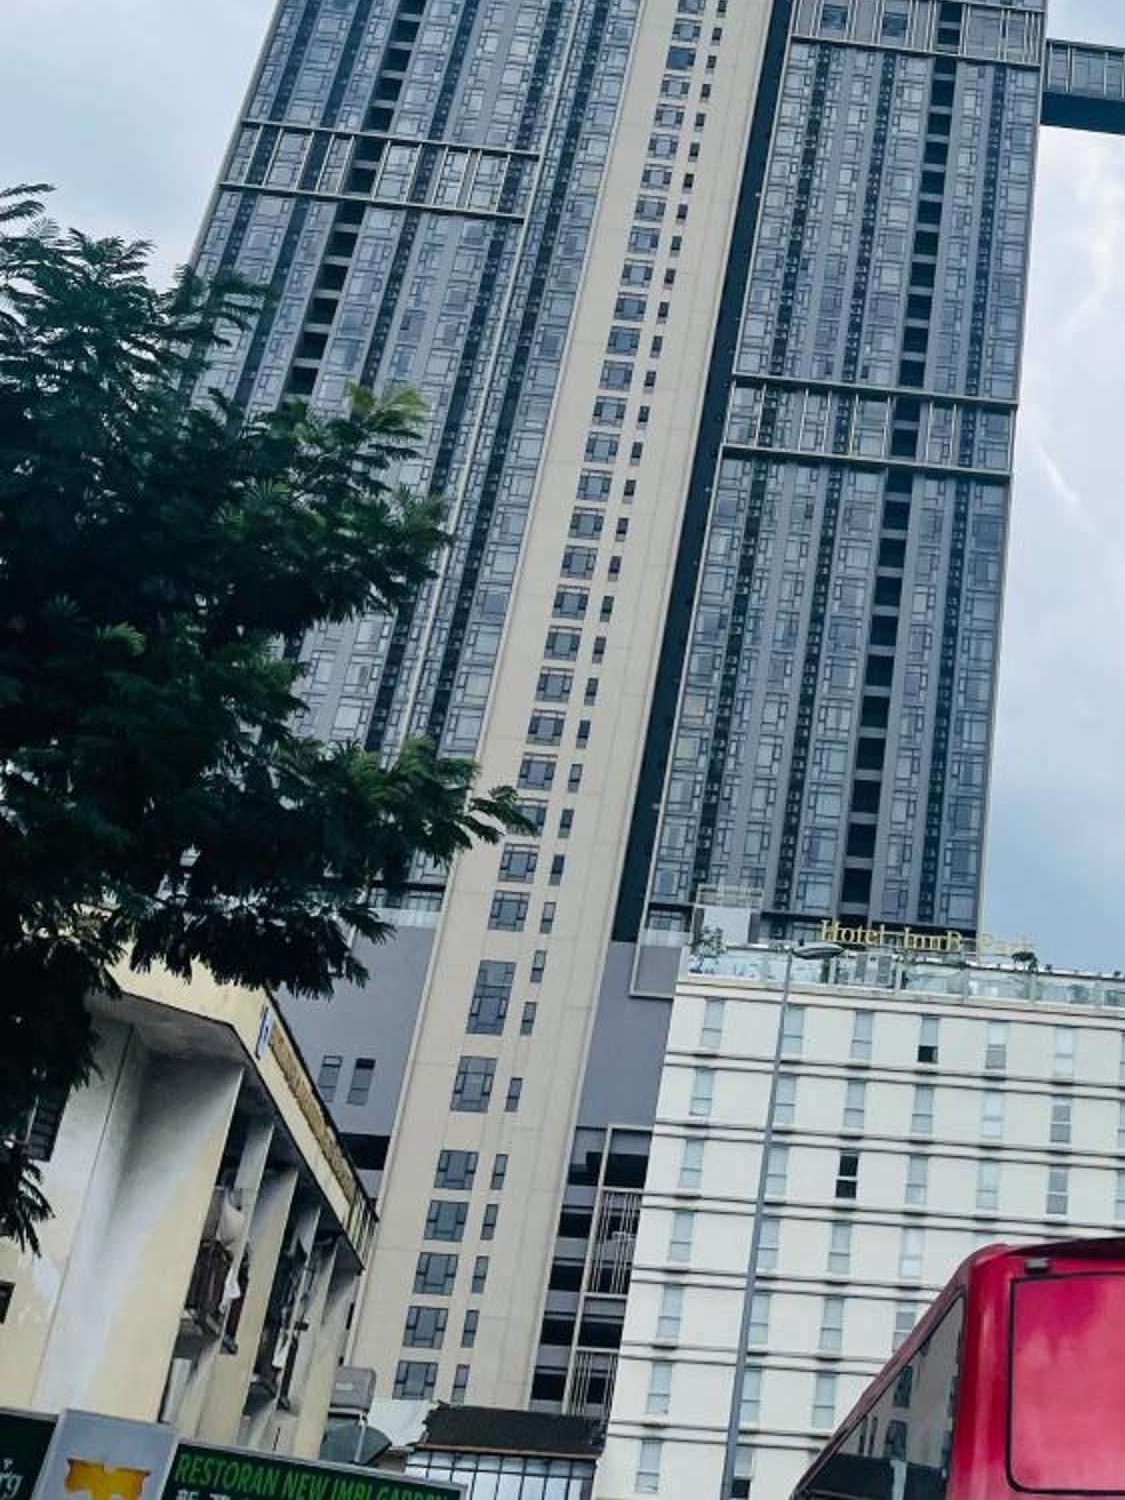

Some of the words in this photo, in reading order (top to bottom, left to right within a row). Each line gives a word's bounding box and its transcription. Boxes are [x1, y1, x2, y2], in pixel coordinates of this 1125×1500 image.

[821, 919, 886, 945] Hotel
[174, 1453, 280, 1496] RESTORAN
[281, 1469, 330, 1500] NEW
